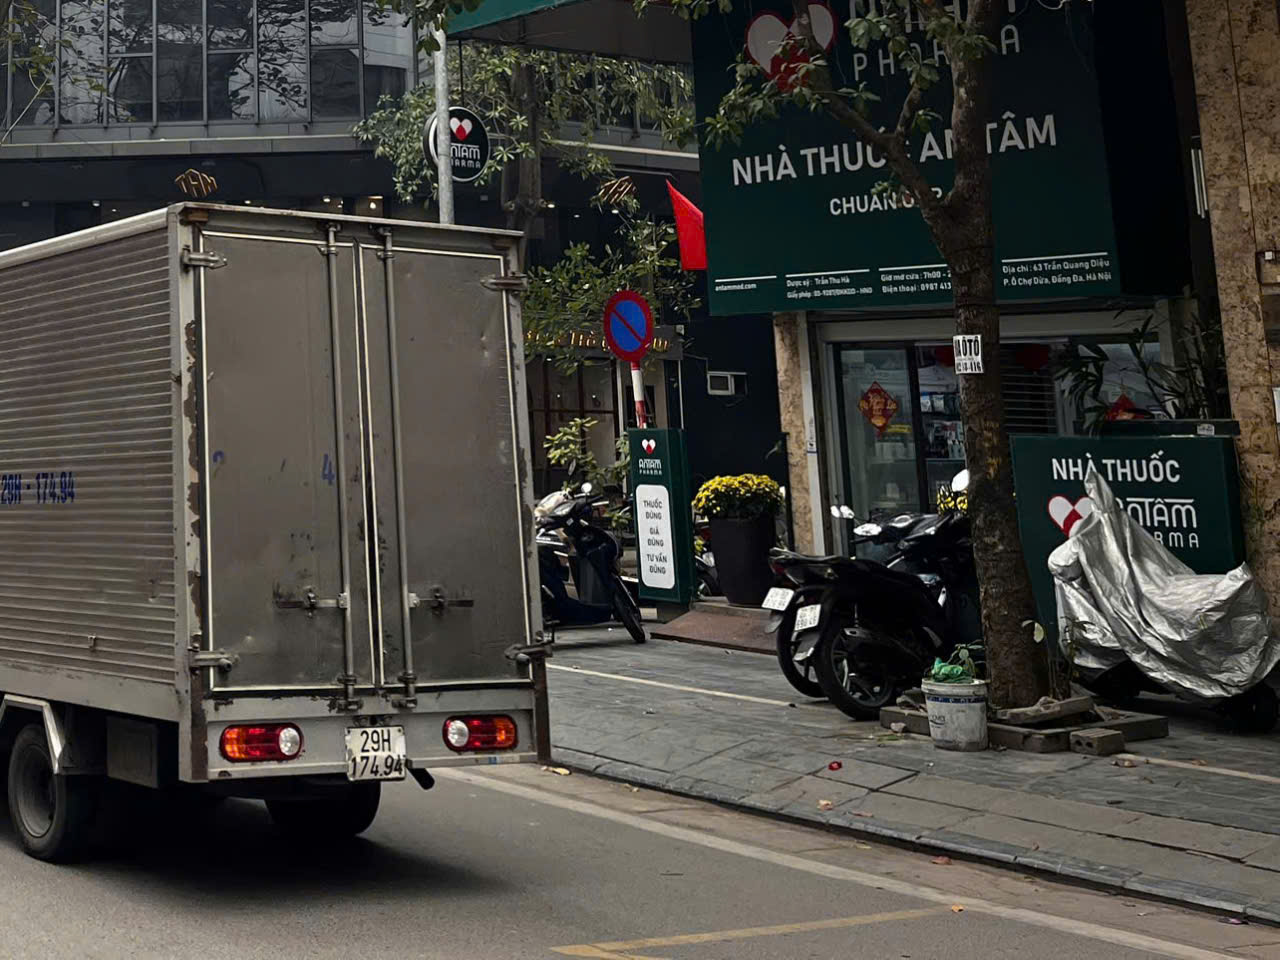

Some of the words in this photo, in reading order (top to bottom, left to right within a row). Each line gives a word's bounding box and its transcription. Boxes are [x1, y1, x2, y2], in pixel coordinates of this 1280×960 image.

[732, 144, 797, 186] NHÀ
[986, 110, 1057, 155] TÂM
[1063, 261, 1089, 270] Quang
[1102, 450, 1181, 483] THUỐC
[1, 474, 21, 504] 29H
[36, 471, 75, 505] 174.94
[1116, 497, 1198, 528] NTÂM
[360, 730, 391, 754] 29H
[350, 755, 404, 779] 174.94
